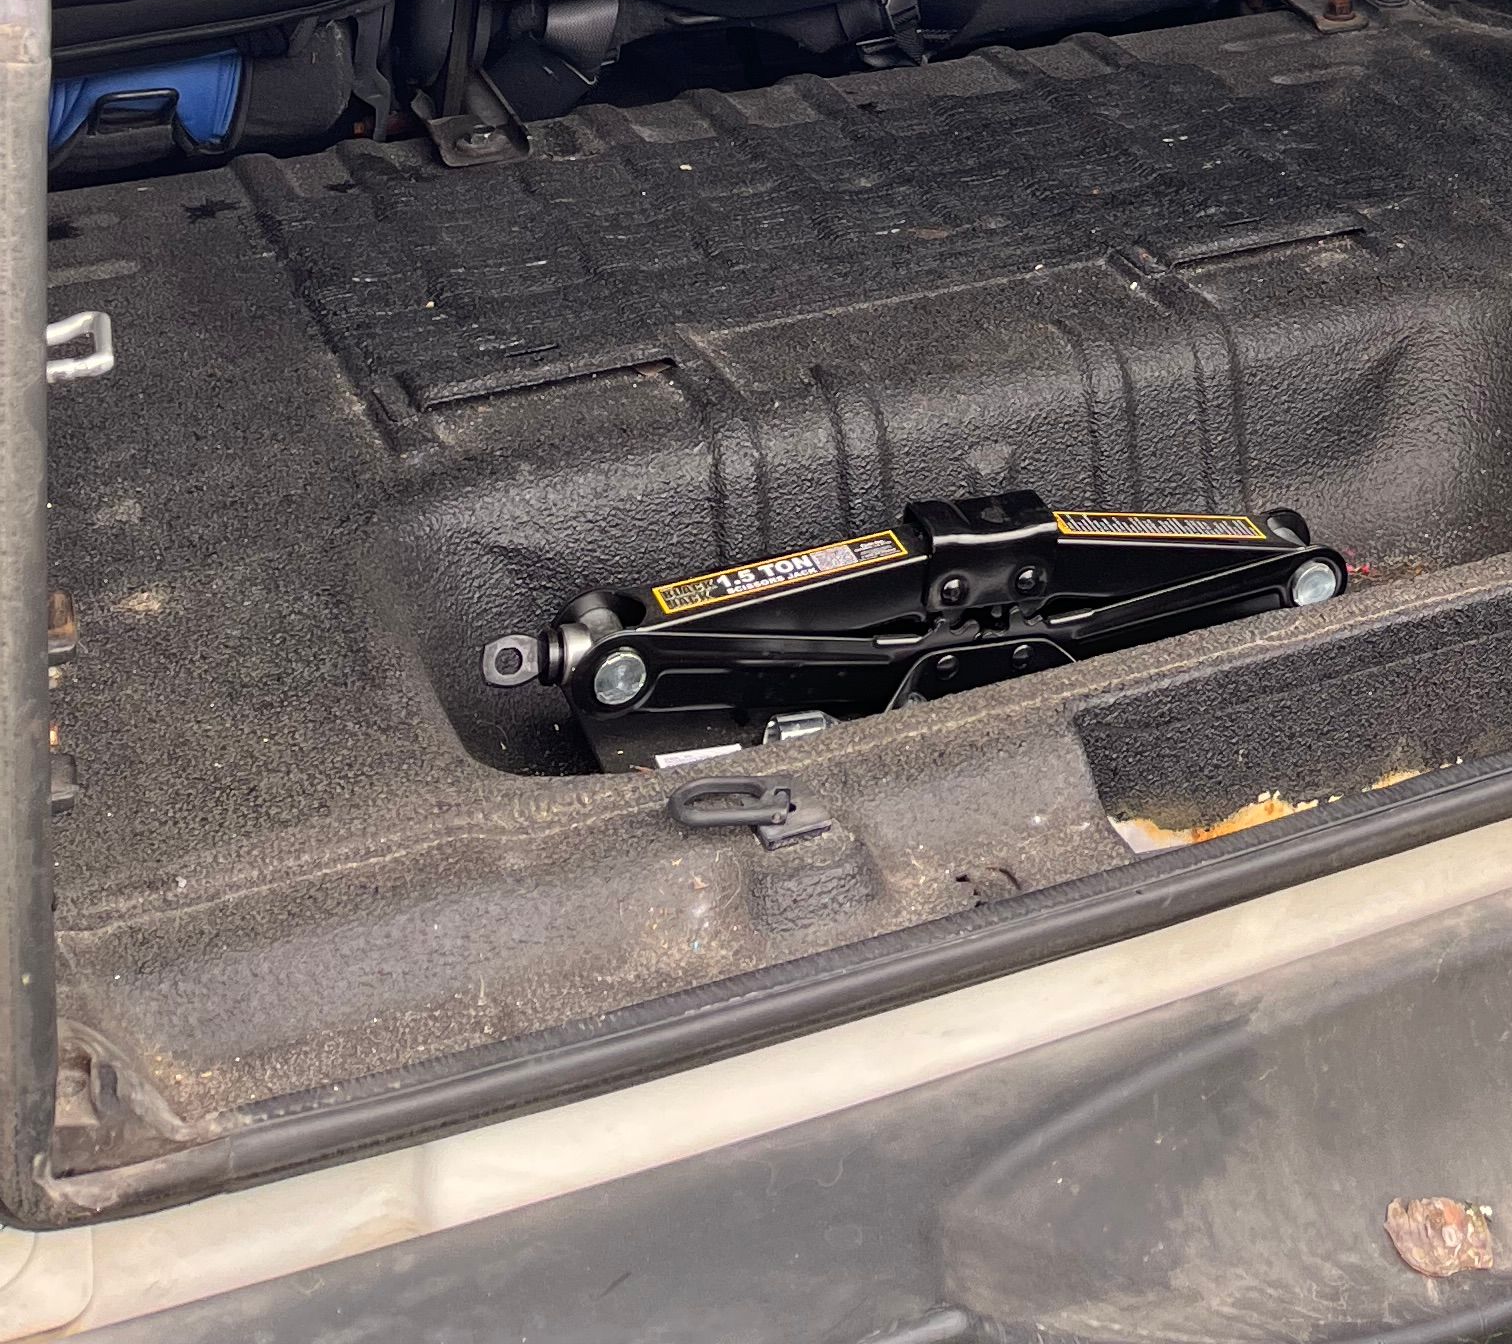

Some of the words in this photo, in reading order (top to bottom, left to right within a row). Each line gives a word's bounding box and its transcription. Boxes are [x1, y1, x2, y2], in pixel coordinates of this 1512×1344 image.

[716, 569, 755, 588] 1.5
[757, 554, 814, 577] TON
[726, 575, 786, 595] SCISSORS
[787, 567, 818, 581] JACK
